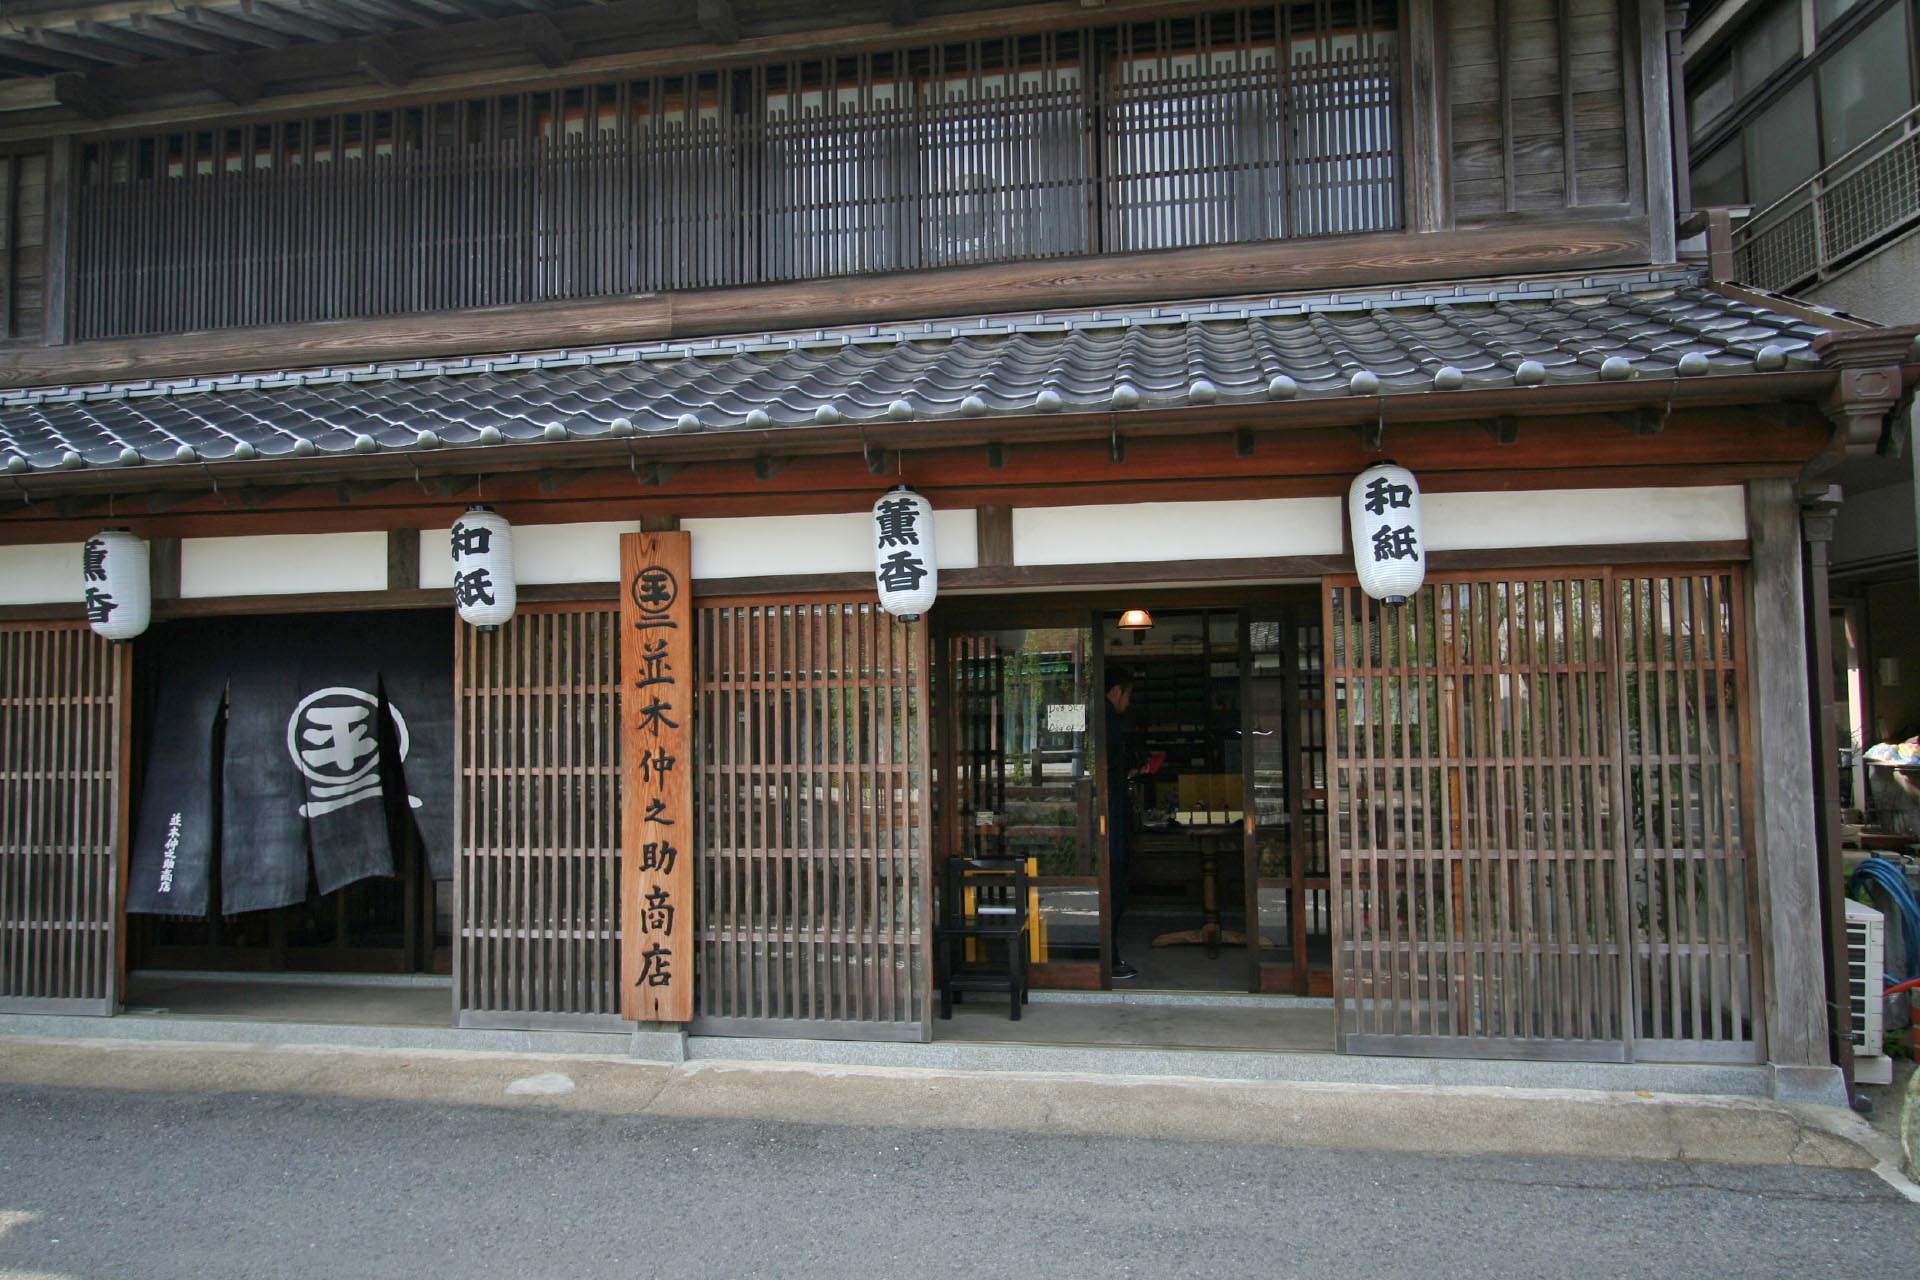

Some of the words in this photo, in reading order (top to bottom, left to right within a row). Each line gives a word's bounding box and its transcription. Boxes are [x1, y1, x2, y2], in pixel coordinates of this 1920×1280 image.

[876, 498, 928, 592] 薫香
[1365, 477, 1419, 562] 和紙
[451, 522, 495, 608] 和紙
[158, 812, 182, 893] 並木仲之助商店
